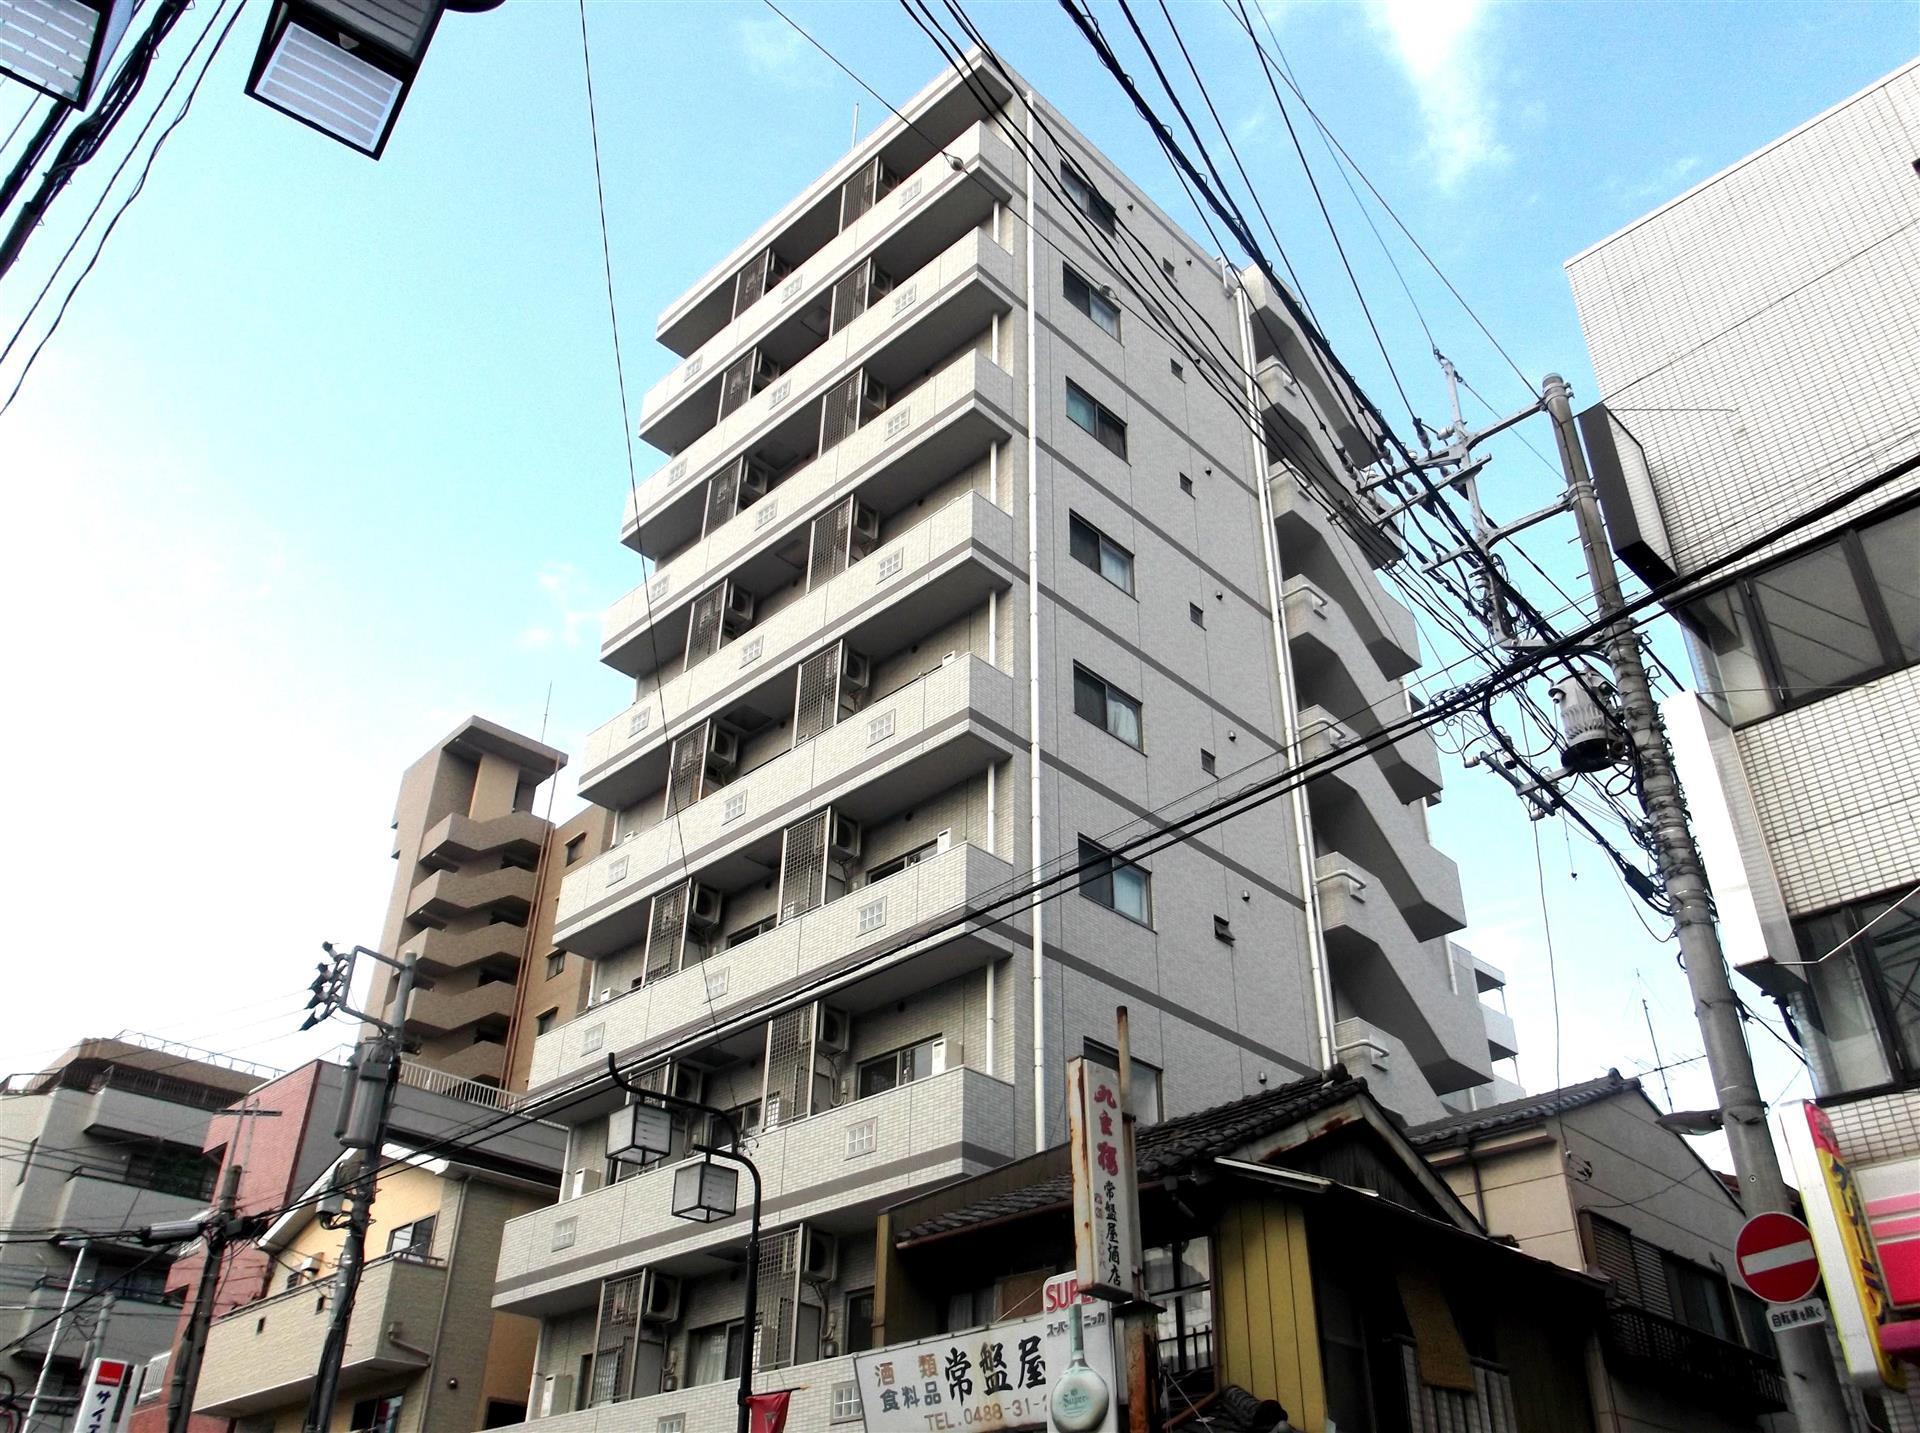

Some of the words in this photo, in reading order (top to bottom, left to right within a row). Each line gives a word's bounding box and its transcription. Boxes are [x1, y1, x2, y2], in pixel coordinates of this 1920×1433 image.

[1046, 1279, 1098, 1312] SUP
[1771, 1305, 1822, 1327] 自転車を除く
[944, 1335, 1047, 1406] 常盤屋
[879, 1381, 942, 1413] 食料品
